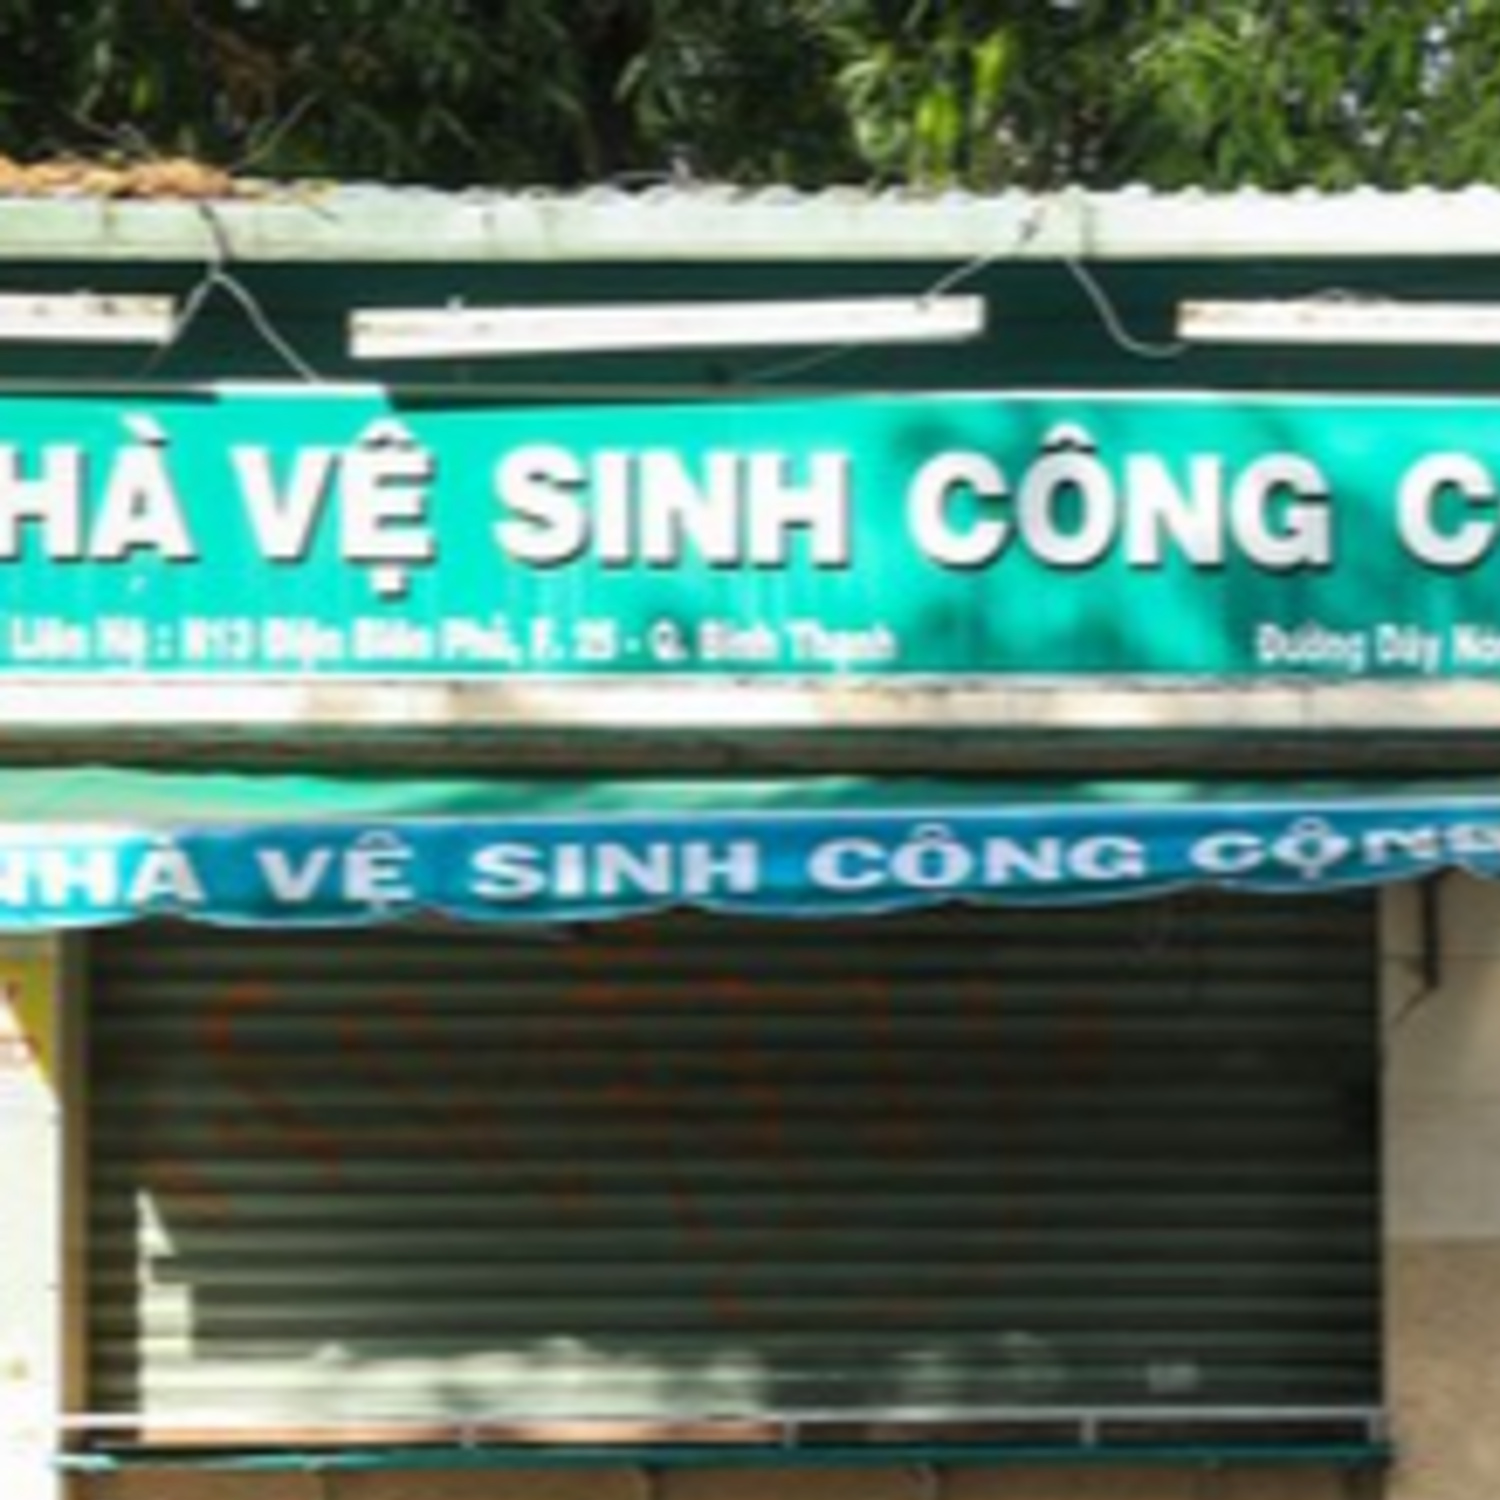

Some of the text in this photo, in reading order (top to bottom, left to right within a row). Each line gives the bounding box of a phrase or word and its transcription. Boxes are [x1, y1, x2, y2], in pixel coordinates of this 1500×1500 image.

[230, 416, 436, 598] VỆ
[492, 446, 850, 570] SINH
[906, 422, 1332, 572] CÔNG
[468, 842, 760, 900] SINH
[808, 824, 1146, 890] CÔNG
